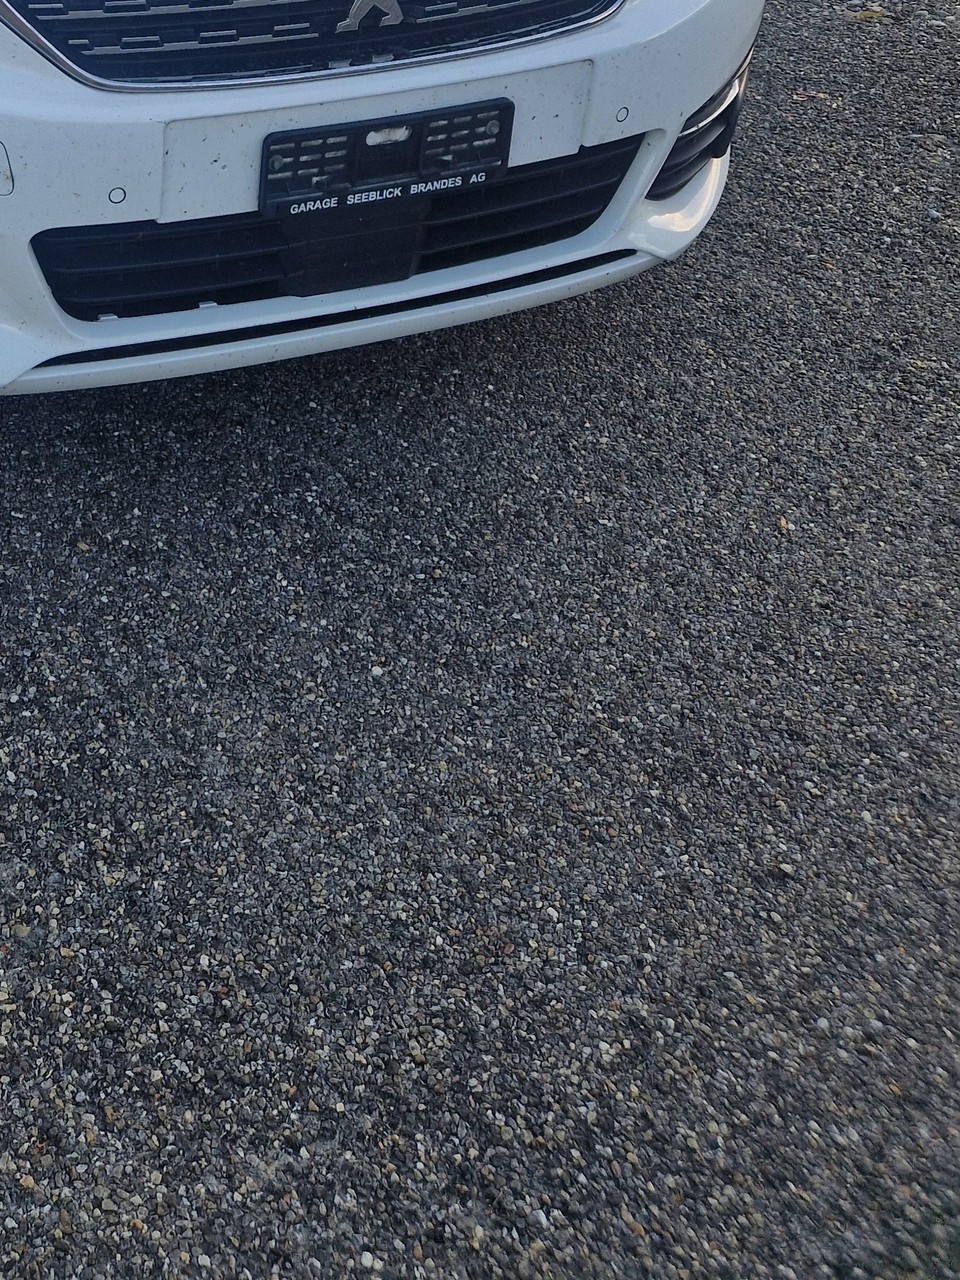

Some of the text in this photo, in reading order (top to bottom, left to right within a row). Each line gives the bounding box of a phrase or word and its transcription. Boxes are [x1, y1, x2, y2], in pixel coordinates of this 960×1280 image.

[290, 172, 486, 214] GARAGE SEEBLICK BRANDES AG
